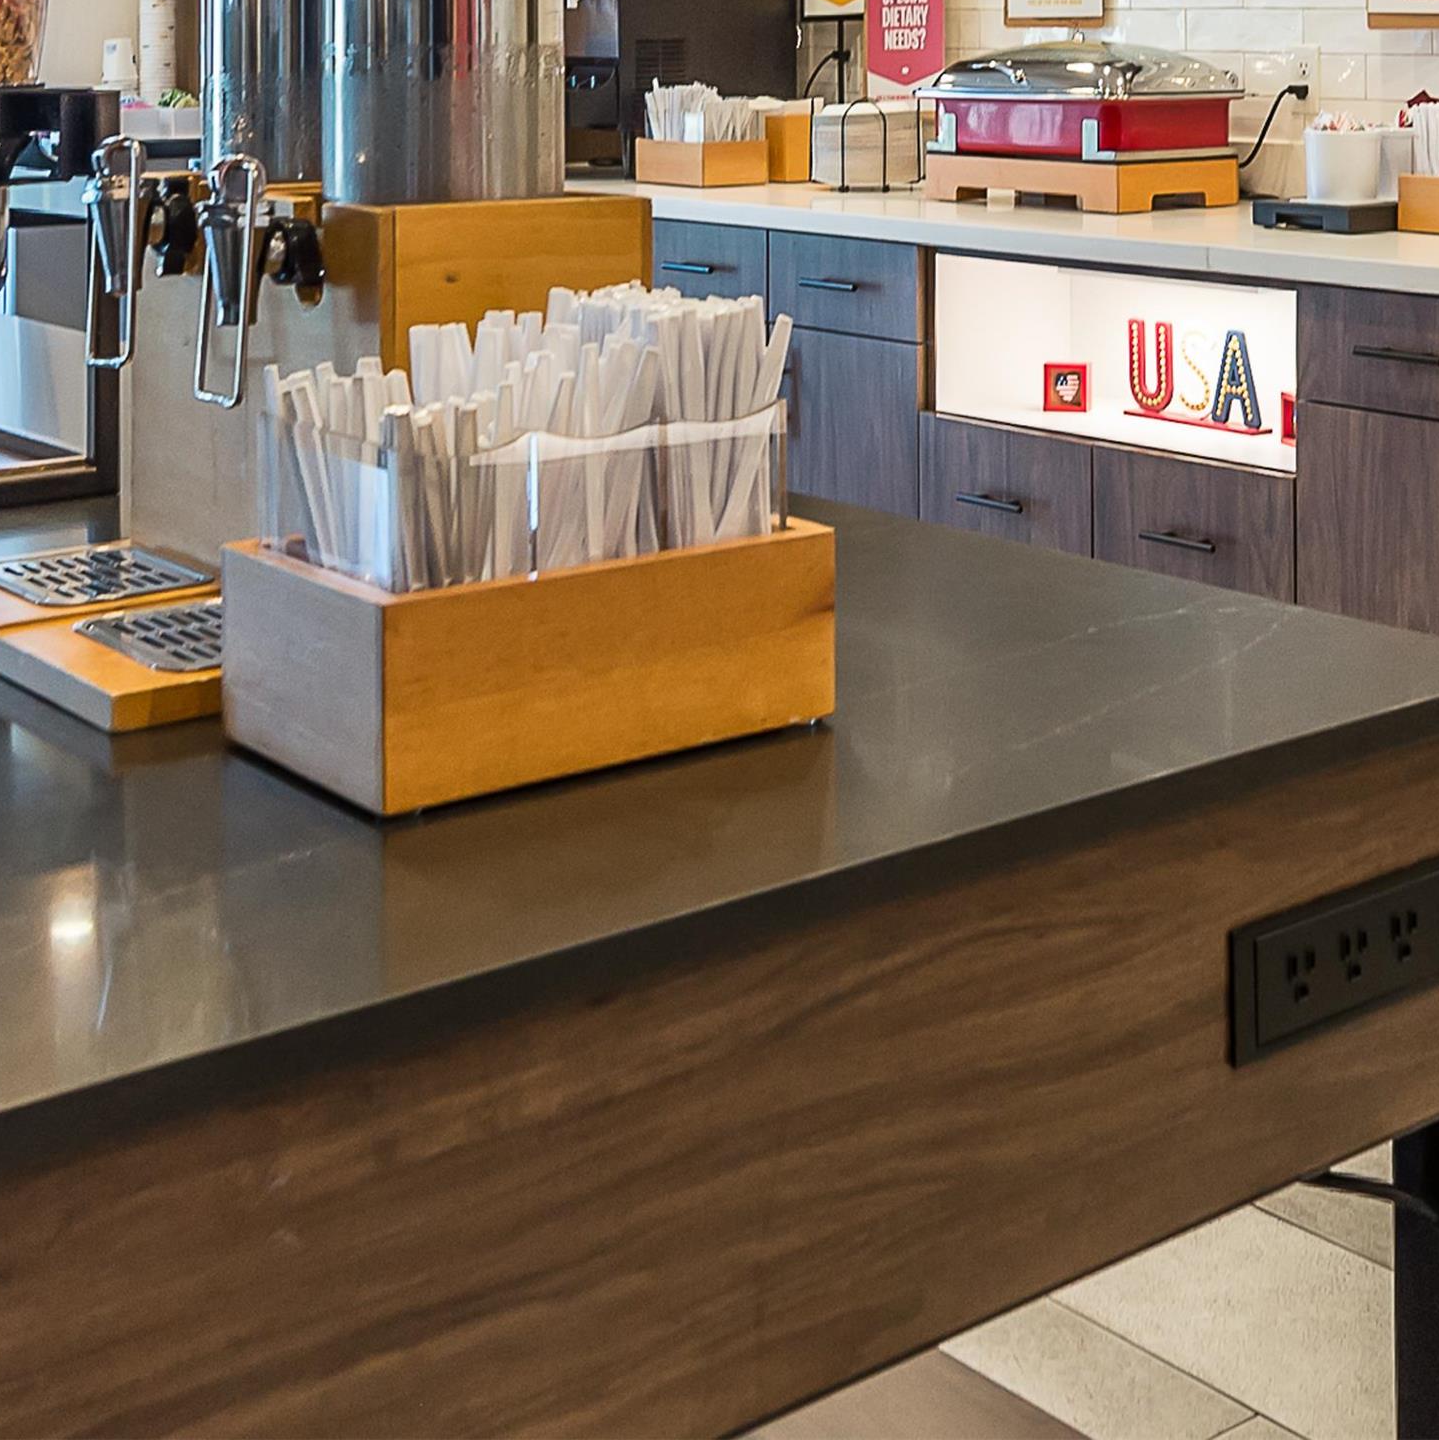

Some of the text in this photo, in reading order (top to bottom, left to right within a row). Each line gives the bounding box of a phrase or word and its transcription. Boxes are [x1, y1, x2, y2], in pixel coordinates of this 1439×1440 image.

[882, 3, 929, 28] DIETARY
[883, 26, 926, 51] NEEDS?
[1128, 318, 1262, 430] USA
